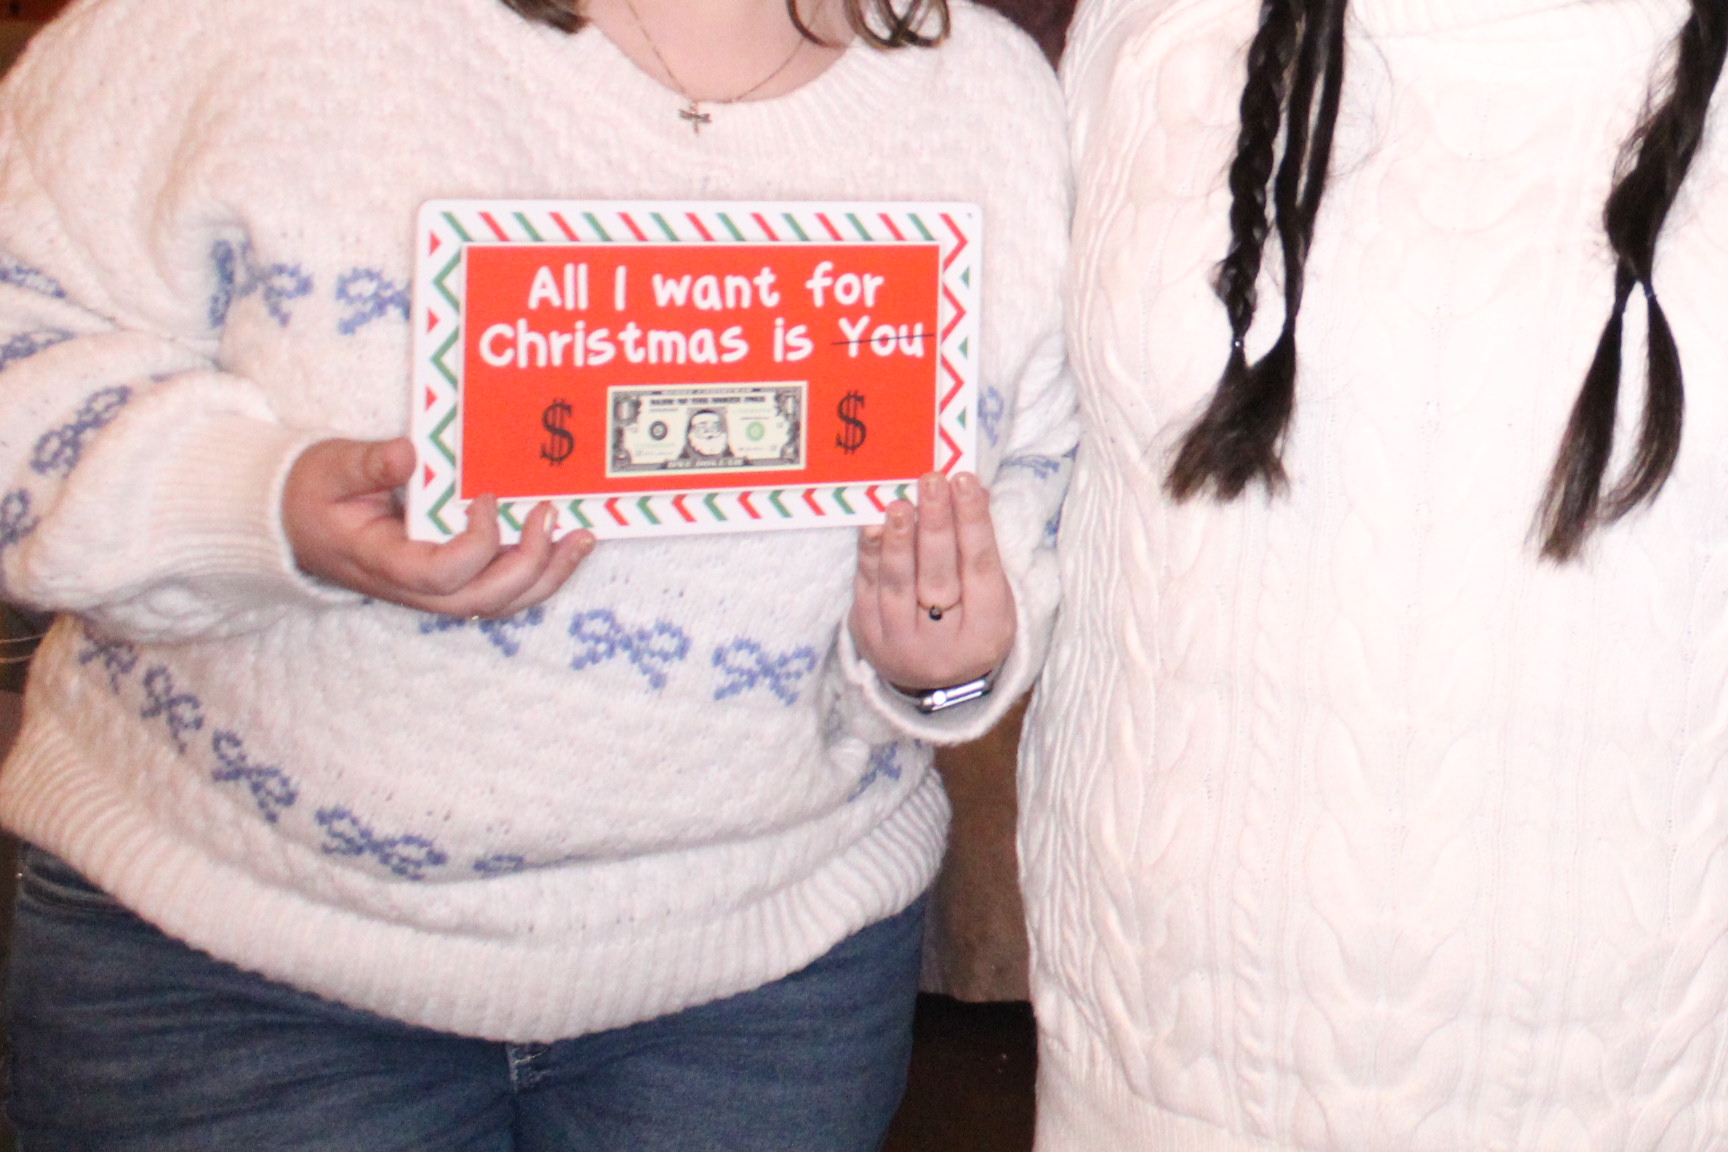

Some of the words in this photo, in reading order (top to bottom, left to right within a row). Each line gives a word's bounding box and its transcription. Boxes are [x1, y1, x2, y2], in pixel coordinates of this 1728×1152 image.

[527, 262, 589, 311] All
[614, 265, 627, 312] I
[652, 266, 781, 311] want
[805, 260, 885, 308] for
[479, 317, 749, 369] Christmas
[773, 317, 814, 363] is
[838, 315, 925, 359] You
